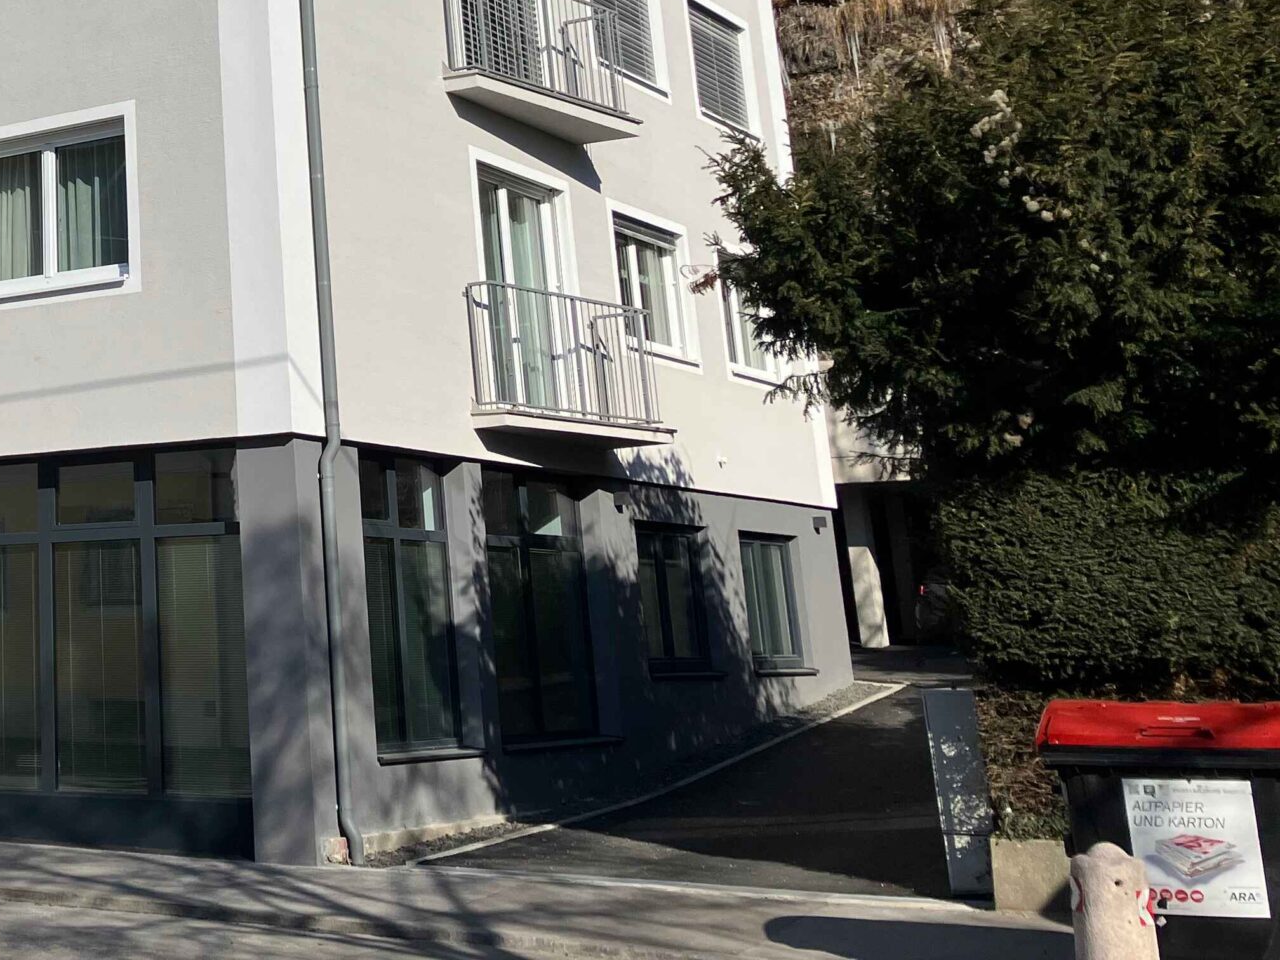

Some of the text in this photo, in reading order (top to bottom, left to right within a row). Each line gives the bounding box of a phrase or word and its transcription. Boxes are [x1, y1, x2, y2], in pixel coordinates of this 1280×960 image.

[1131, 799, 1205, 814] ALTPAPIER
[1132, 815, 1226, 830] UND KARTON
[1229, 891, 1257, 902] ARA
